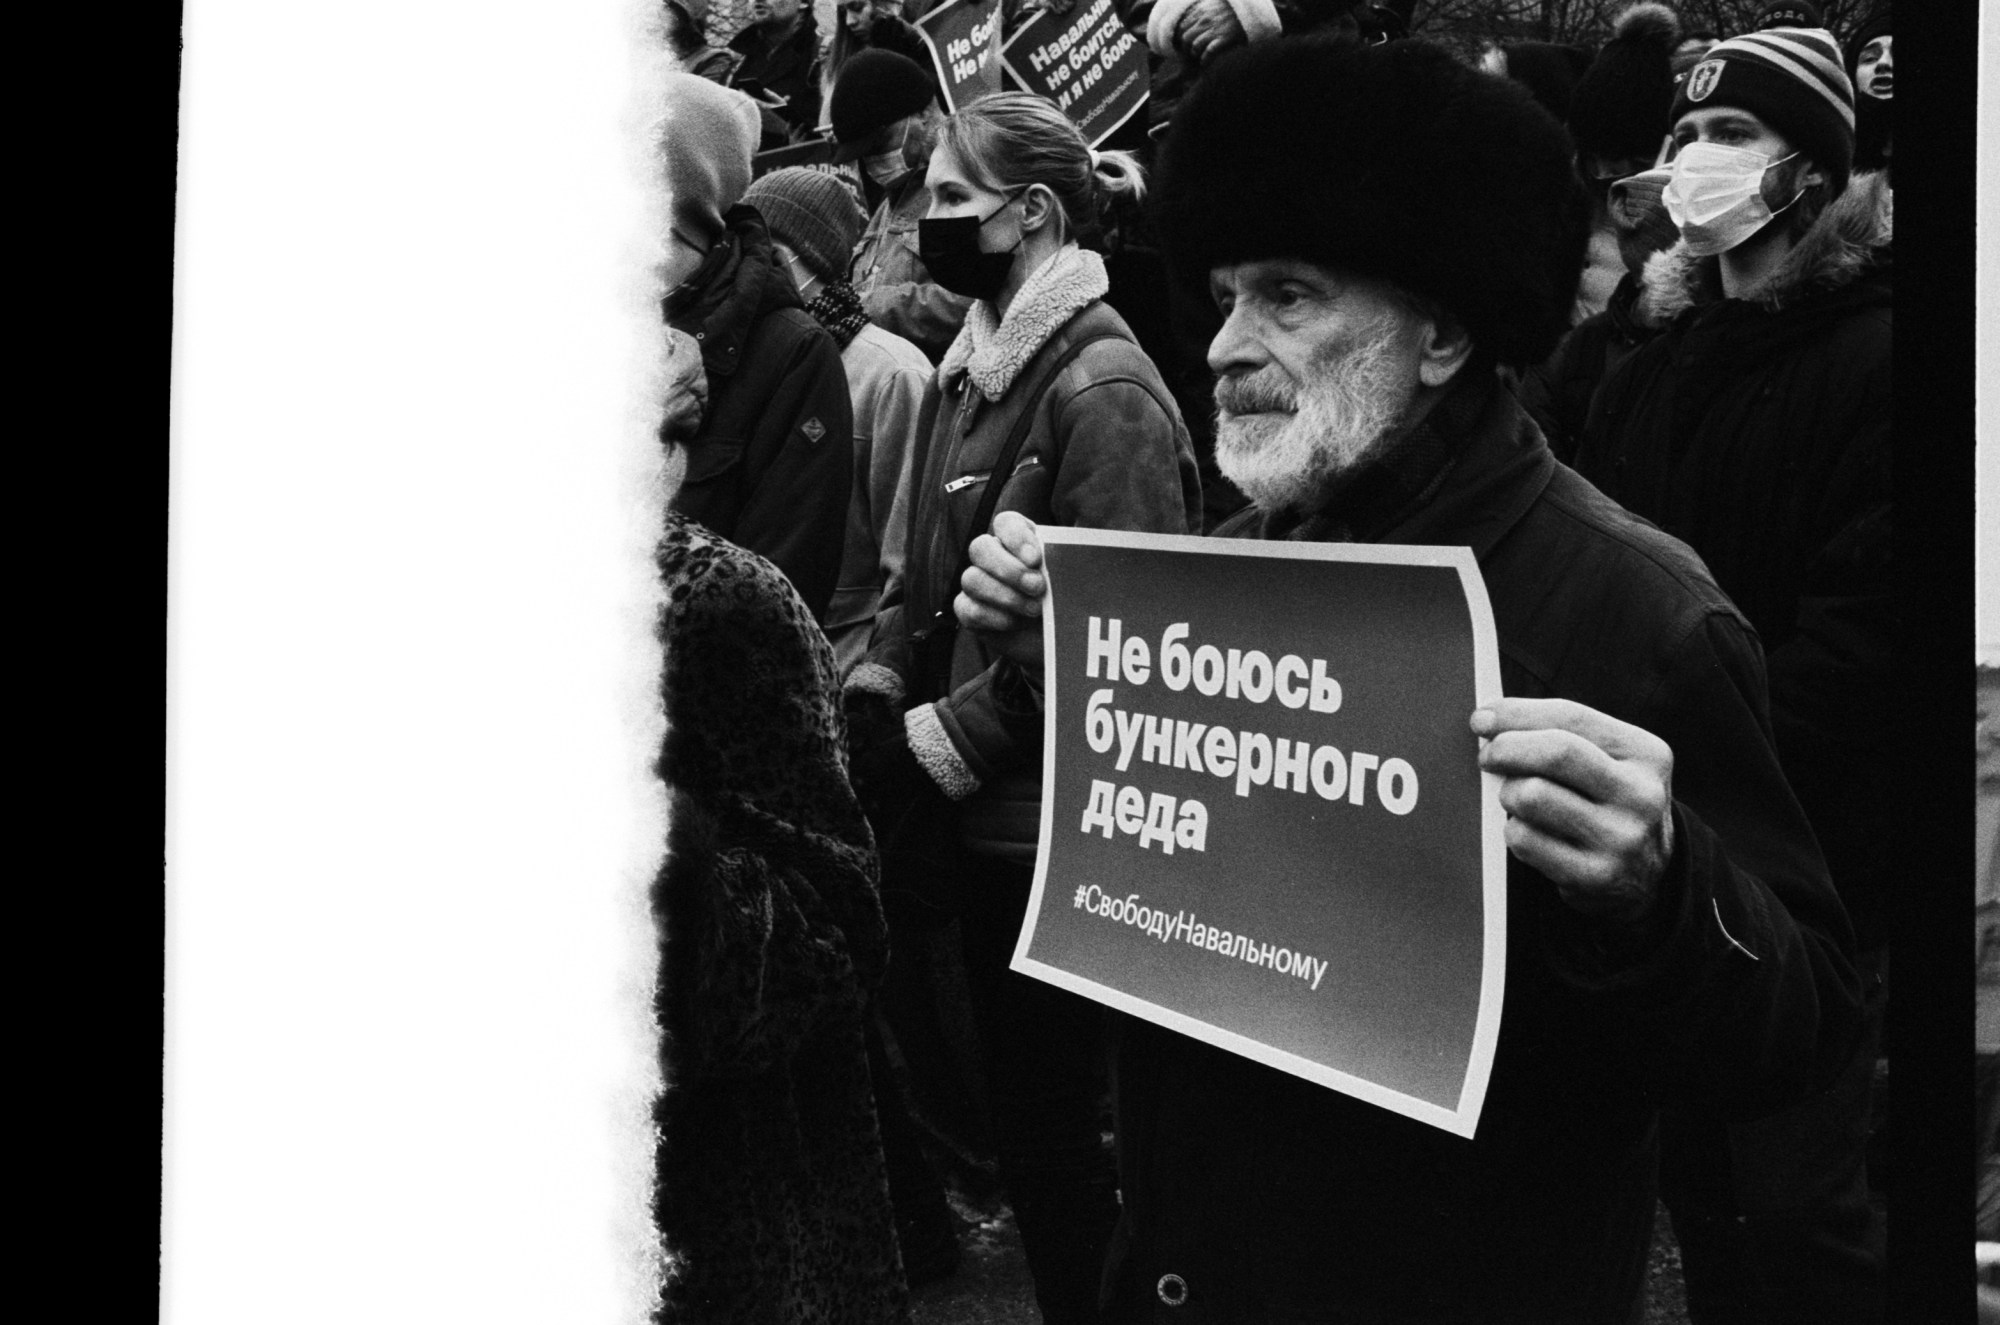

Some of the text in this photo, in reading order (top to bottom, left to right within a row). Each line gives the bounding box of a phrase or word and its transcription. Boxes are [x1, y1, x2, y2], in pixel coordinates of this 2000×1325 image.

[947, 38, 971, 63] Не
[1028, 0, 1112, 72] Навальны
[952, 58, 978, 84] Не
[1045, 63, 1071, 91] не
[1058, 90, 1072, 111] и
[1070, 80, 1084, 100] я
[1082, 63, 1103, 90] не
[1074, 70, 1139, 130] СвободуНавальному
[1086, 616, 1342, 713] Не боюсь
[1085, 688, 1419, 815] бункерного
[1080, 778, 1209, 855] деда
[1074, 884, 1329, 991] #СвободуНавальному
